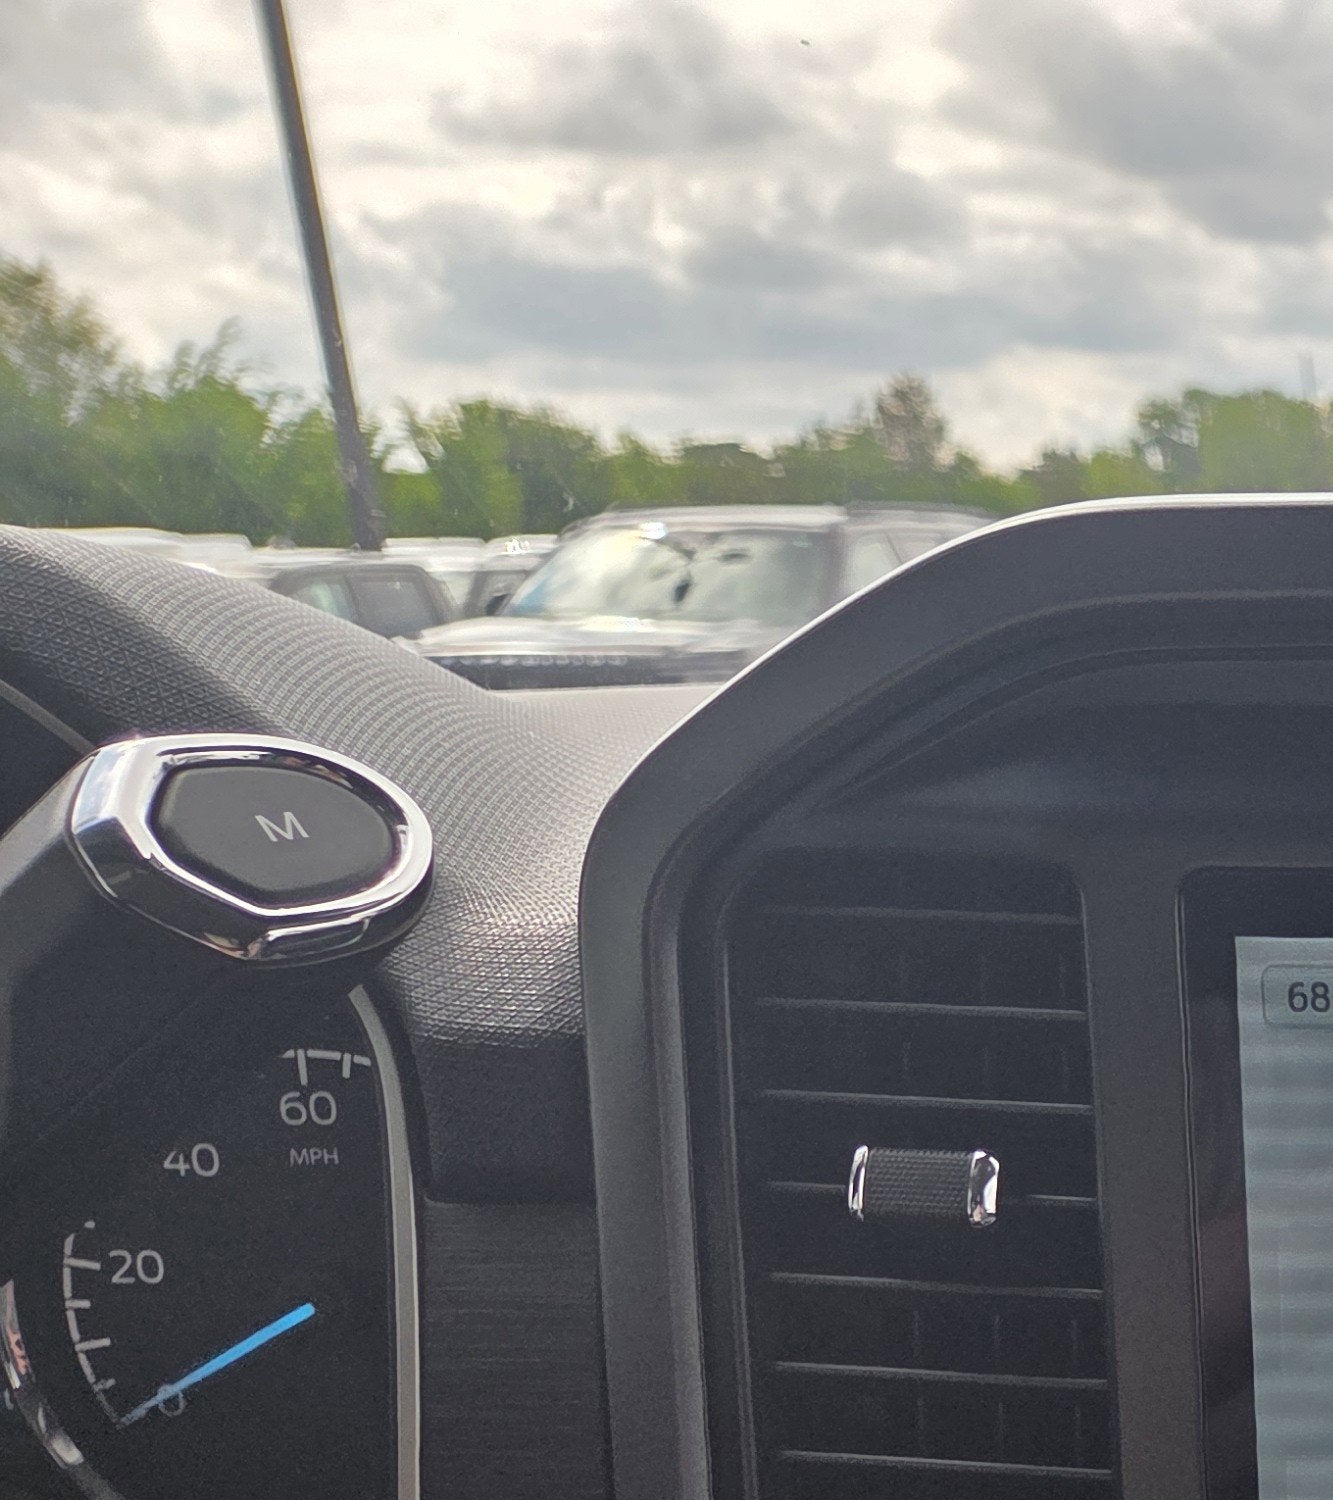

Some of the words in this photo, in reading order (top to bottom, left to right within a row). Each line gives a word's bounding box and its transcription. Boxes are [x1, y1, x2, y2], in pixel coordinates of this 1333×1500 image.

[255, 811, 309, 842] M
[279, 1090, 338, 1126] 60
[163, 1143, 220, 1177] 40
[289, 1147, 340, 1165] MPH
[109, 1249, 165, 1284] 20
